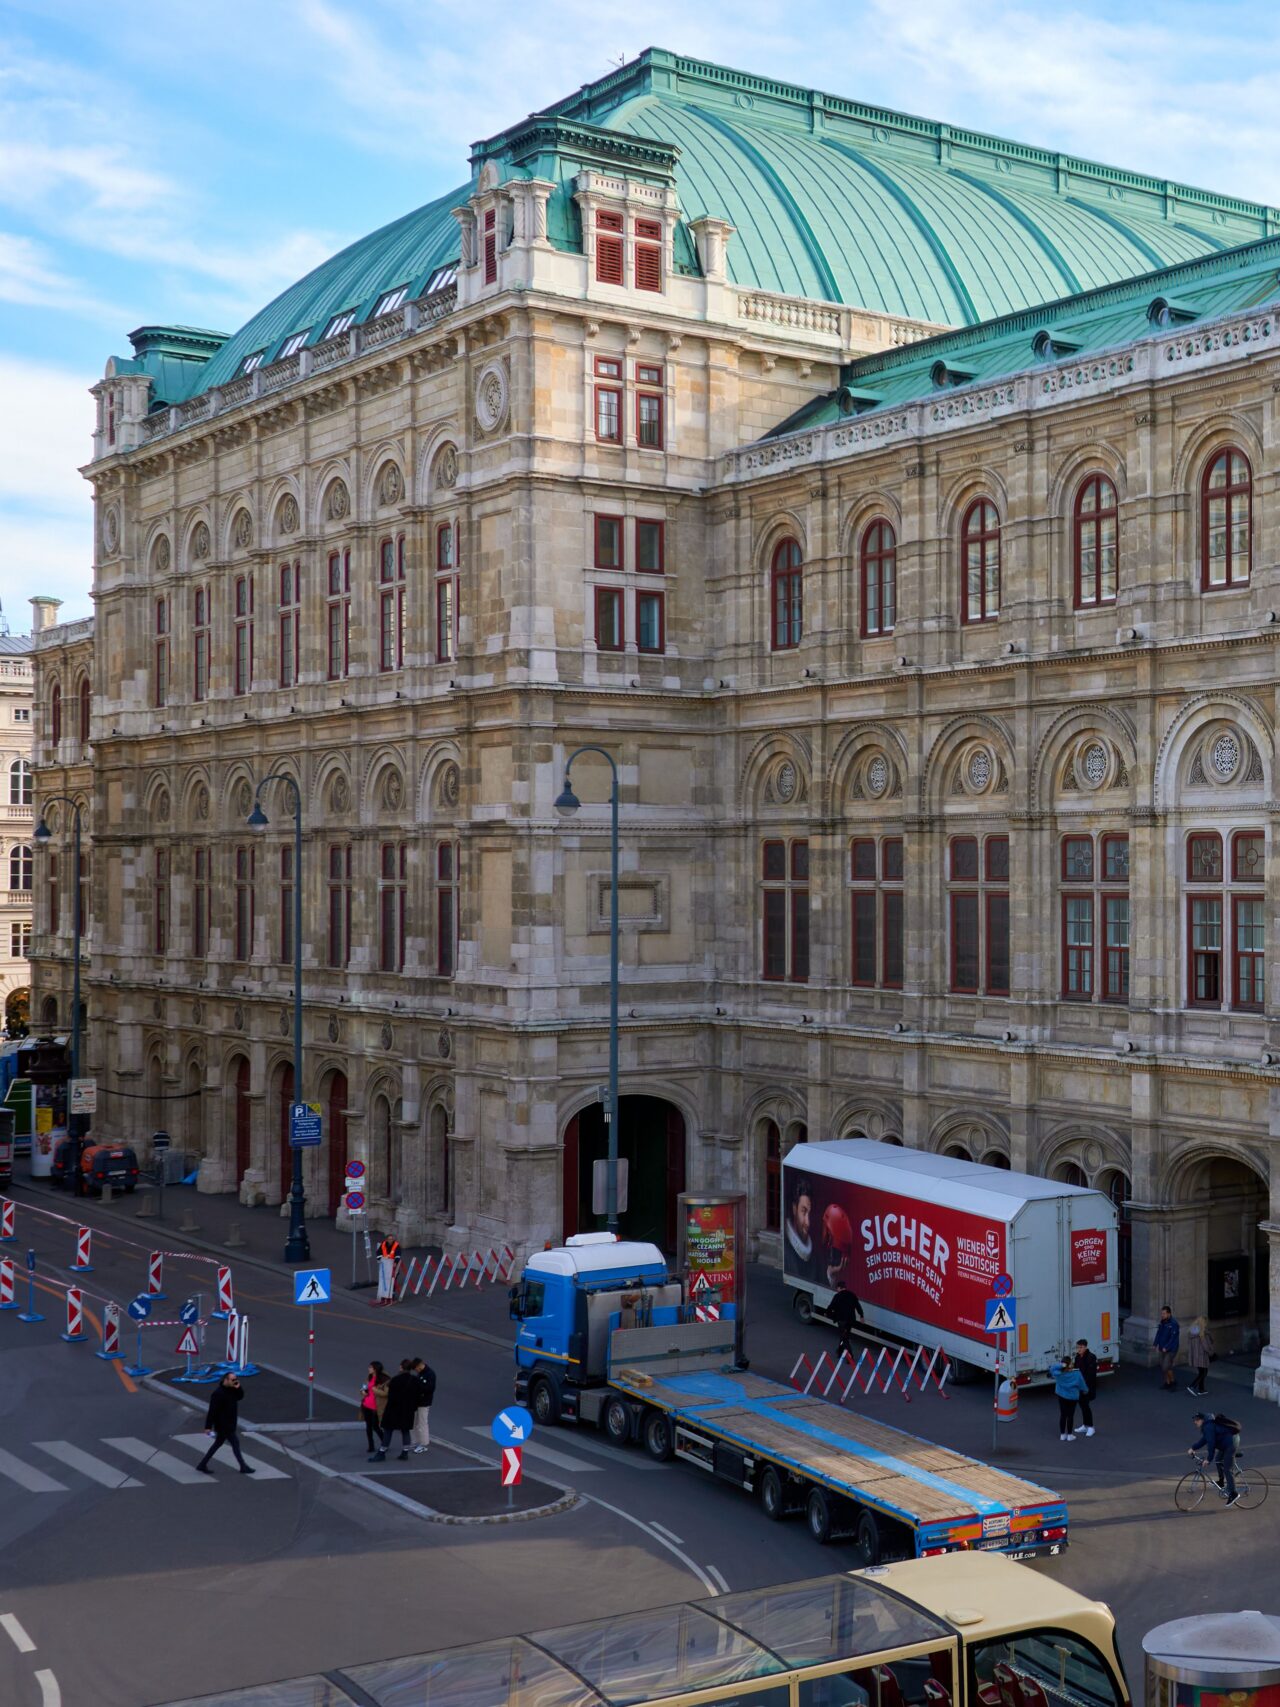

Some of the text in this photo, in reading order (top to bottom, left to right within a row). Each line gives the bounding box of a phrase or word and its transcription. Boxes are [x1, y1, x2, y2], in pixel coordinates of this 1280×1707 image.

[861, 1213, 950, 1276] SICHER
[957, 1236, 985, 1256] WIENER
[1074, 1238, 1104, 1249] SORGEN
[957, 1251, 999, 1274] STÄDTISCHE
[1078, 1250, 1101, 1260] KEINE
[866, 1252, 944, 1294] SEIN ODER NICHT SEIN,
[869, 1268, 941, 1306] DAS IST KEINE FRAGE.
[1103, 1346, 1109, 1354] 3
